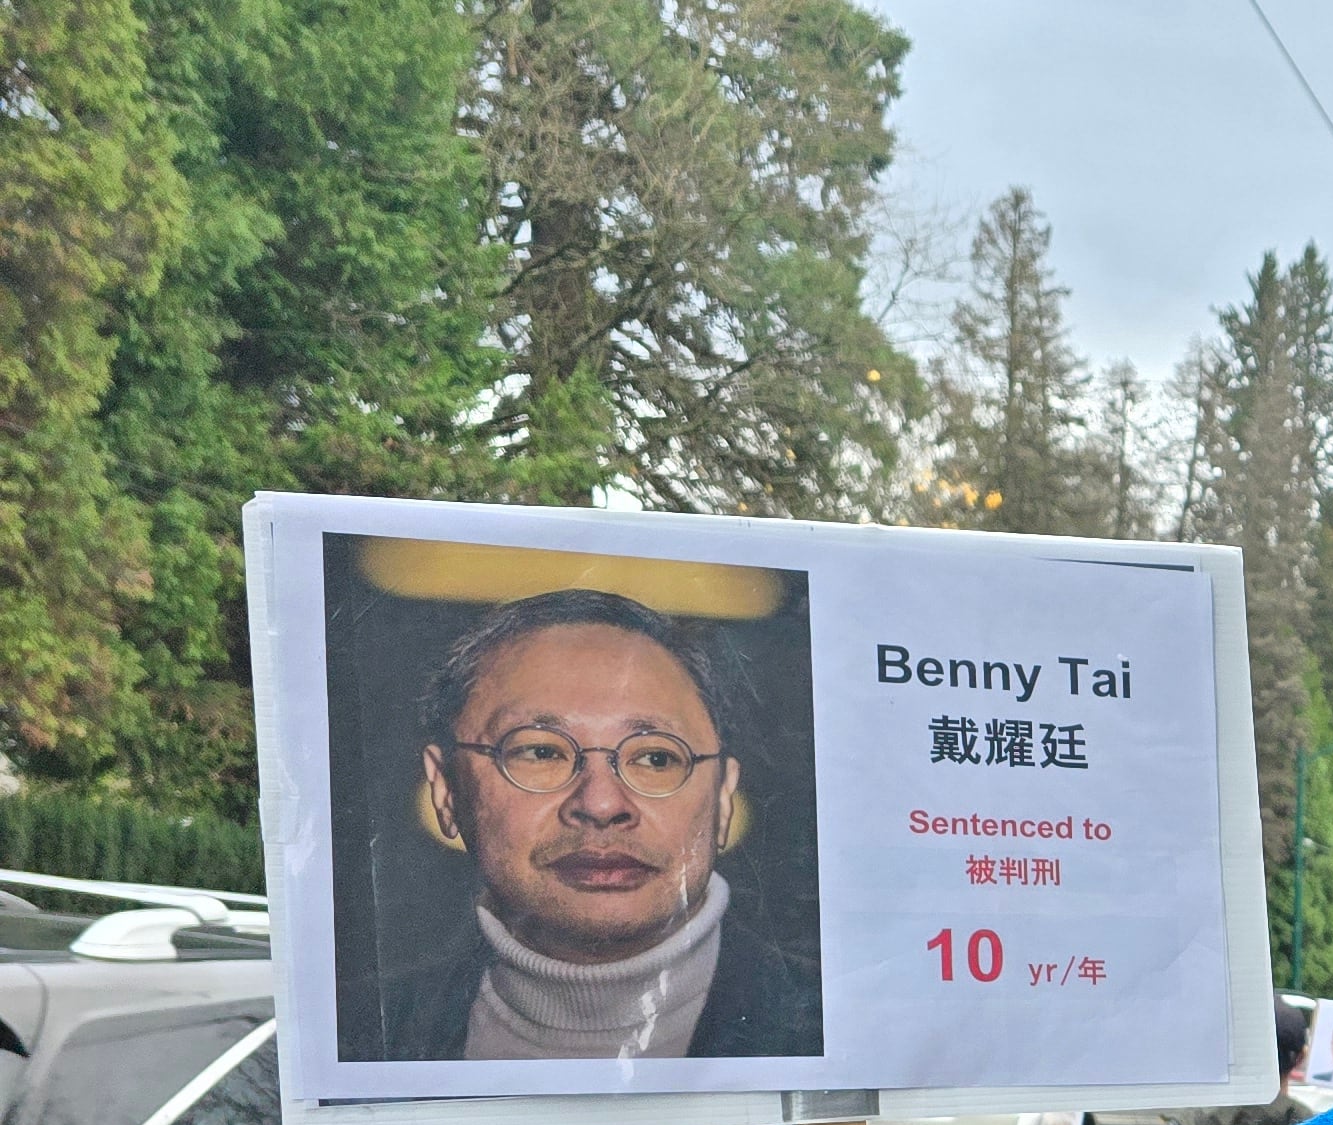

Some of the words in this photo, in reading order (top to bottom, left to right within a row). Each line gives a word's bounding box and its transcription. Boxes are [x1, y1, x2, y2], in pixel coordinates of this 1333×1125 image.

[877, 643, 1041, 702] Benny
[1058, 656, 1131, 699] Tai
[928, 714, 1089, 769] 戴耀廷
[909, 809, 1073, 839] Sentenced
[1083, 818, 1112, 841] to
[965, 854, 1061, 886] 被判刑
[927, 928, 1004, 983] 10
[1028, 955, 1107, 986] yr/年
